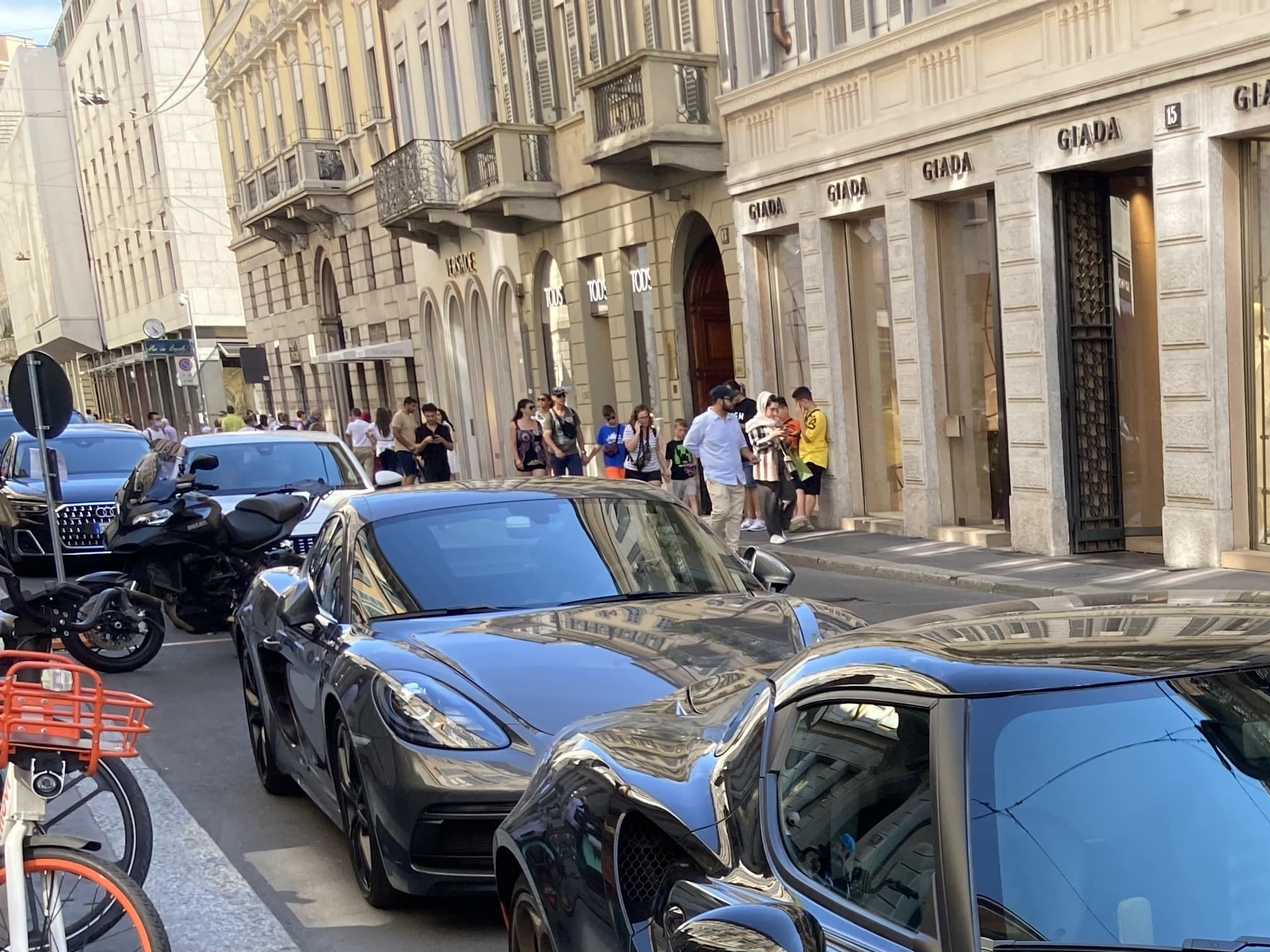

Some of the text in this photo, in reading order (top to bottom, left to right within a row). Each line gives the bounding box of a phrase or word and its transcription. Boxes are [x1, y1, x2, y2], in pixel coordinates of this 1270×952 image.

[1166, 104, 1178, 126] 15
[1057, 116, 1121, 151] GIADA
[922, 151, 974, 181] GIADA
[827, 176, 870, 202] GIADA
[748, 197, 784, 220] GIADA
